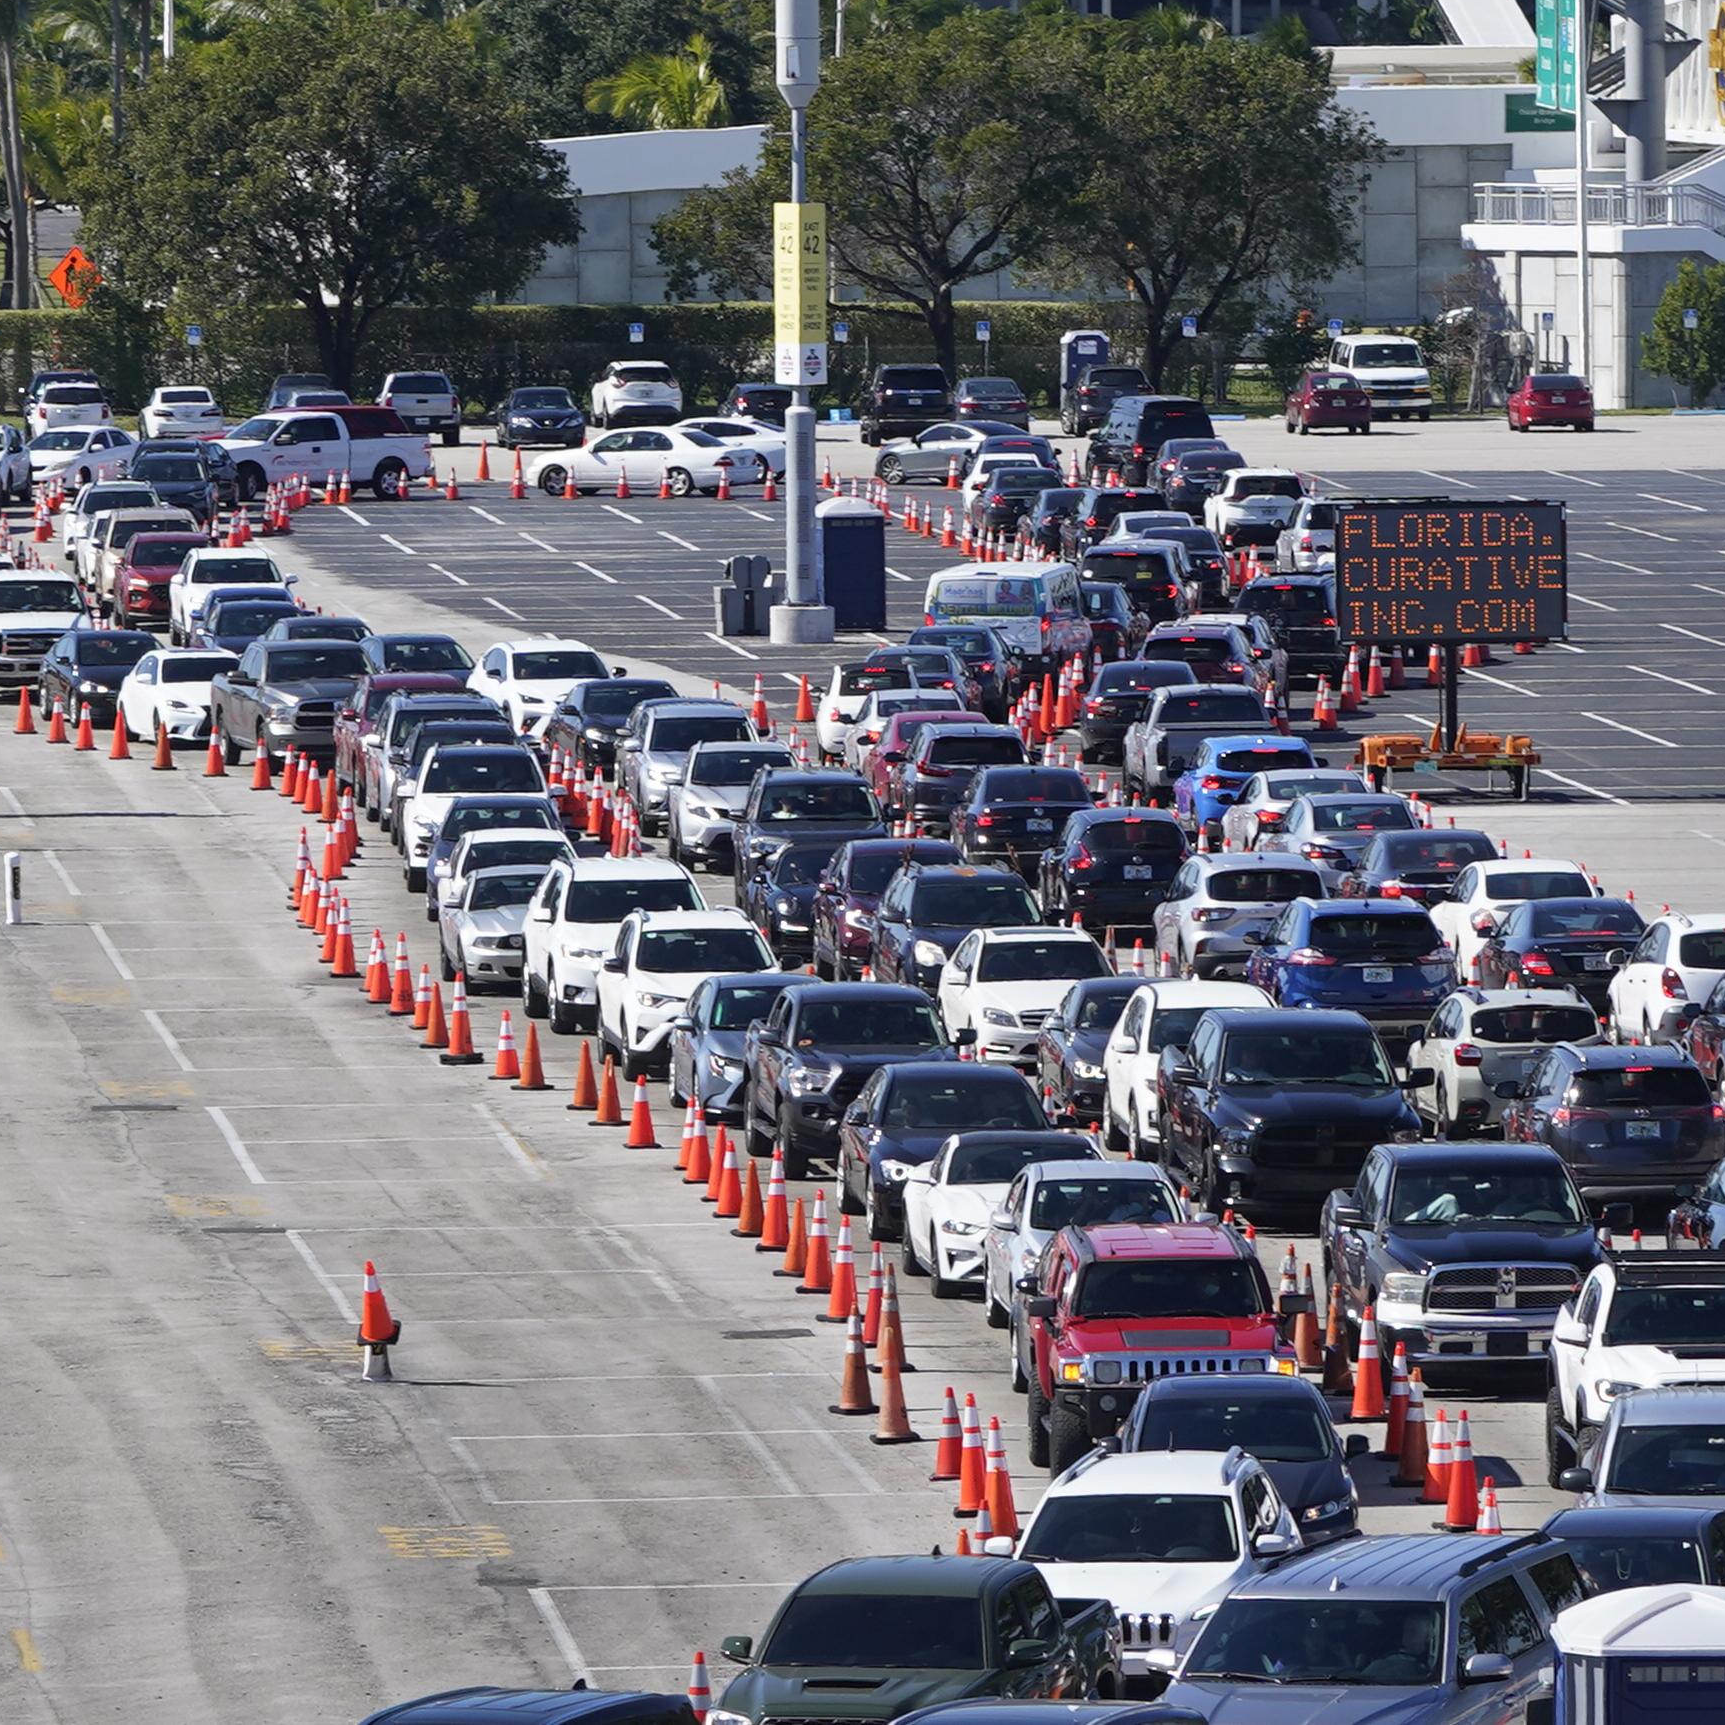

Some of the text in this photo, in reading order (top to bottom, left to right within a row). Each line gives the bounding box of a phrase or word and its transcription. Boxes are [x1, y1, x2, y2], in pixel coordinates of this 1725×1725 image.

[803, 235, 820, 254] 42
[1343, 512, 1553, 549] FLORIDA.
[1343, 555, 1564, 592] CURATIVE
[1349, 598, 1536, 636] INC.COM
